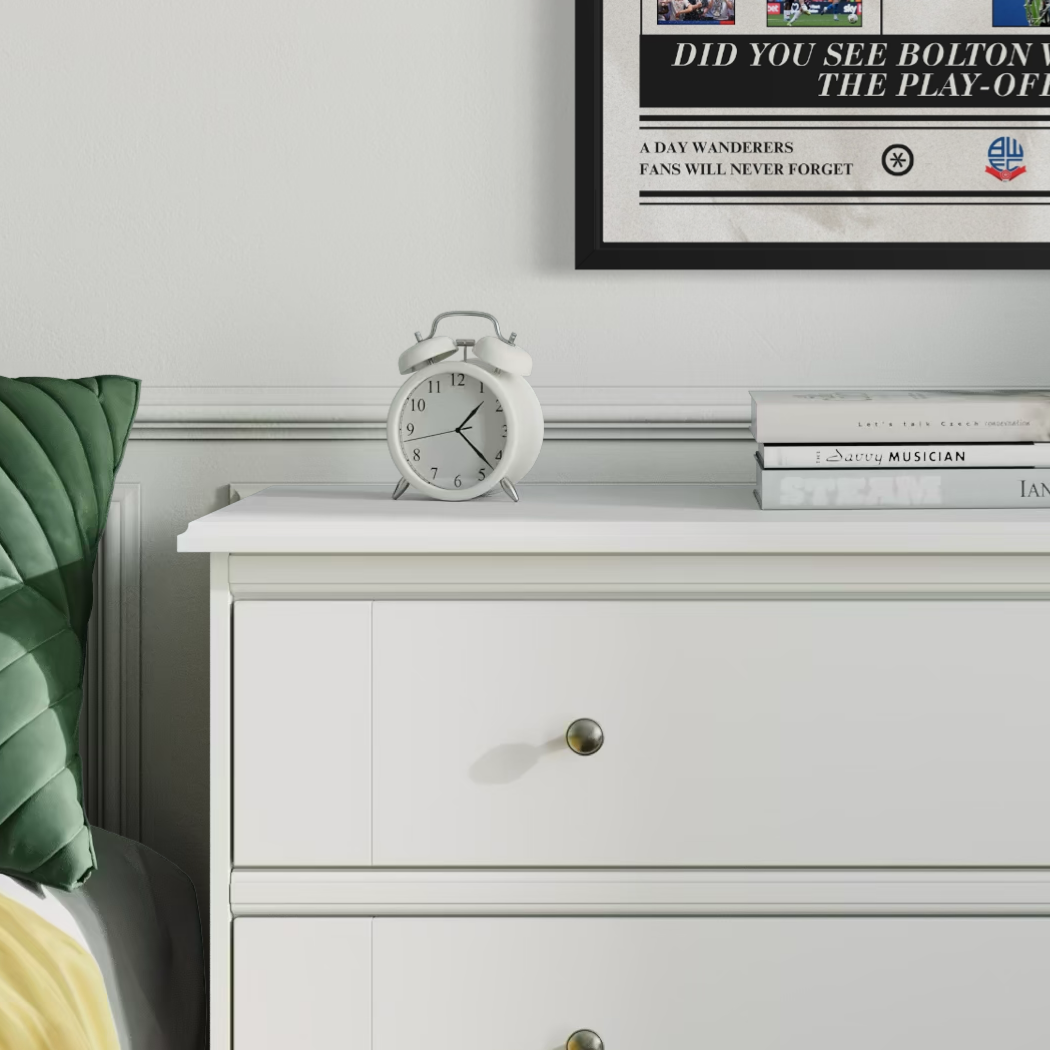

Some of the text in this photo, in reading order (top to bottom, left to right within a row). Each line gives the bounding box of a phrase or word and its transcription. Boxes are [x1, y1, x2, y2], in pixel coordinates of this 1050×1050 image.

[843, 4, 857, 15] sky
[671, 43, 737, 66] DID
[750, 43, 816, 66] YOU
[823, 43, 887, 66] SEE
[896, 43, 1033, 66] BOLTON
[818, 73, 887, 96] THE
[640, 142, 793, 153] A DAY WANDERERS
[641, 163, 853, 175] FANS WILL NEVER FORGET
[450, 372, 466, 387] 12
[428, 380, 442, 394] 11
[479, 381, 485, 394] 1
[410, 398, 426, 412] 10
[406, 423, 415, 436] 9
[857, 420, 894, 428] Let's
[412, 448, 421, 462] 8
[826, 448, 883, 465] Savvy
[888, 451, 966, 463] MUSICIAN
[430, 466, 438, 480] 7
[478, 468, 486, 481] 5
[453, 474, 462, 488] 6
